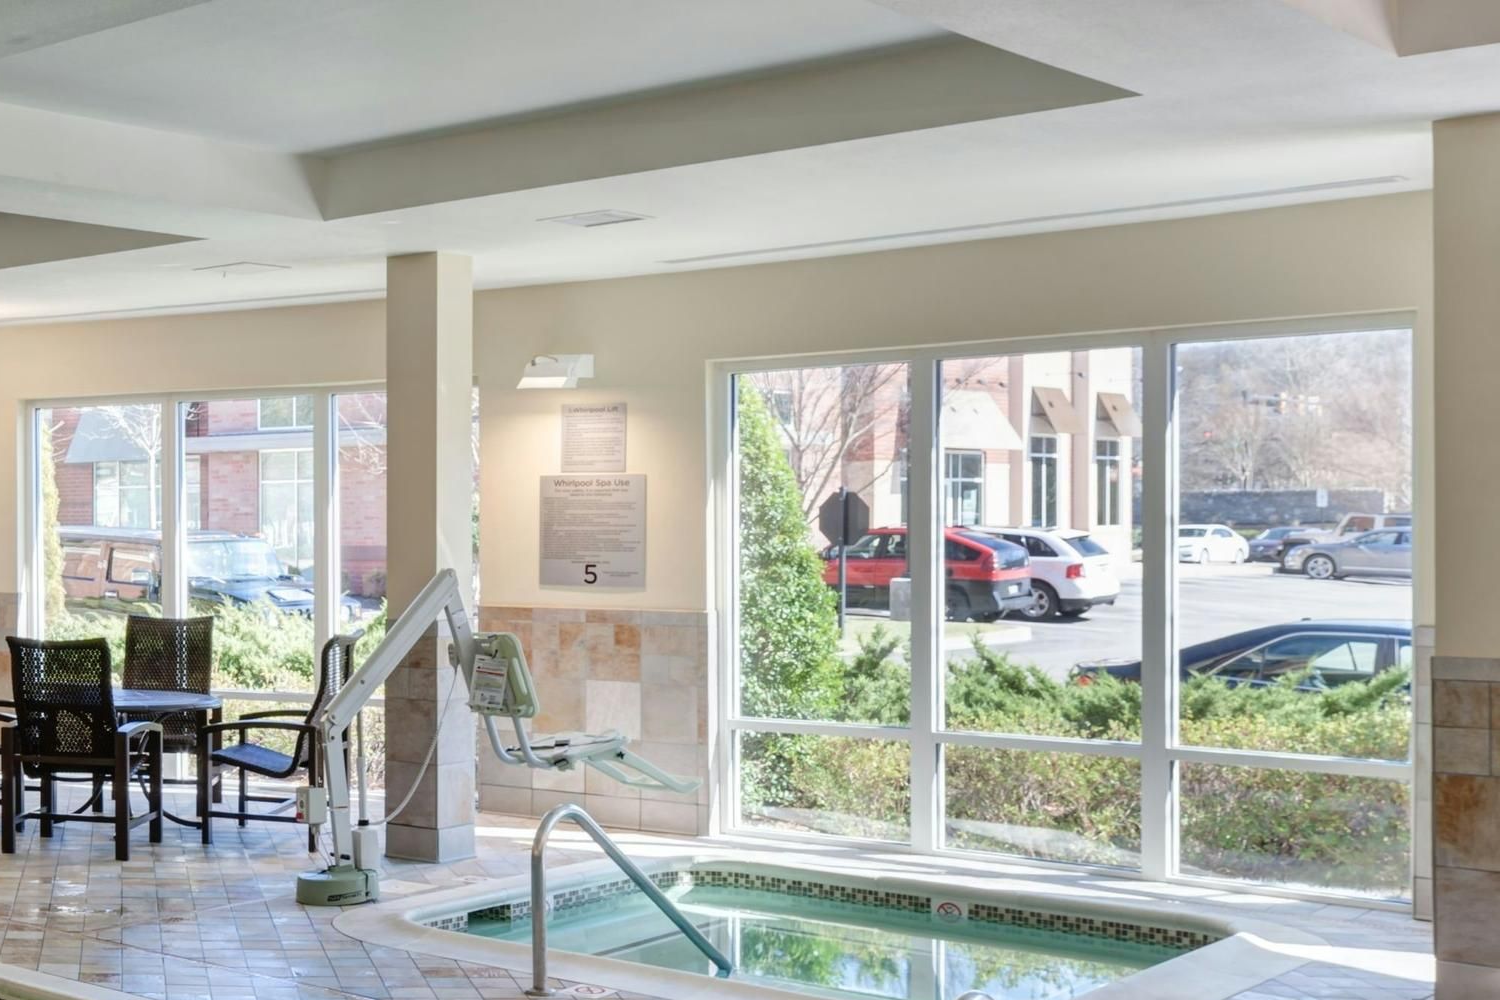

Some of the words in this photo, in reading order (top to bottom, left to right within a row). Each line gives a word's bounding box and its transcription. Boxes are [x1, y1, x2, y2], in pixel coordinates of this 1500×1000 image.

[553, 479, 593, 488] Whirlpool
[595, 479, 612, 488] Spa
[614, 478, 630, 487] Use
[583, 564, 598, 585] 5
